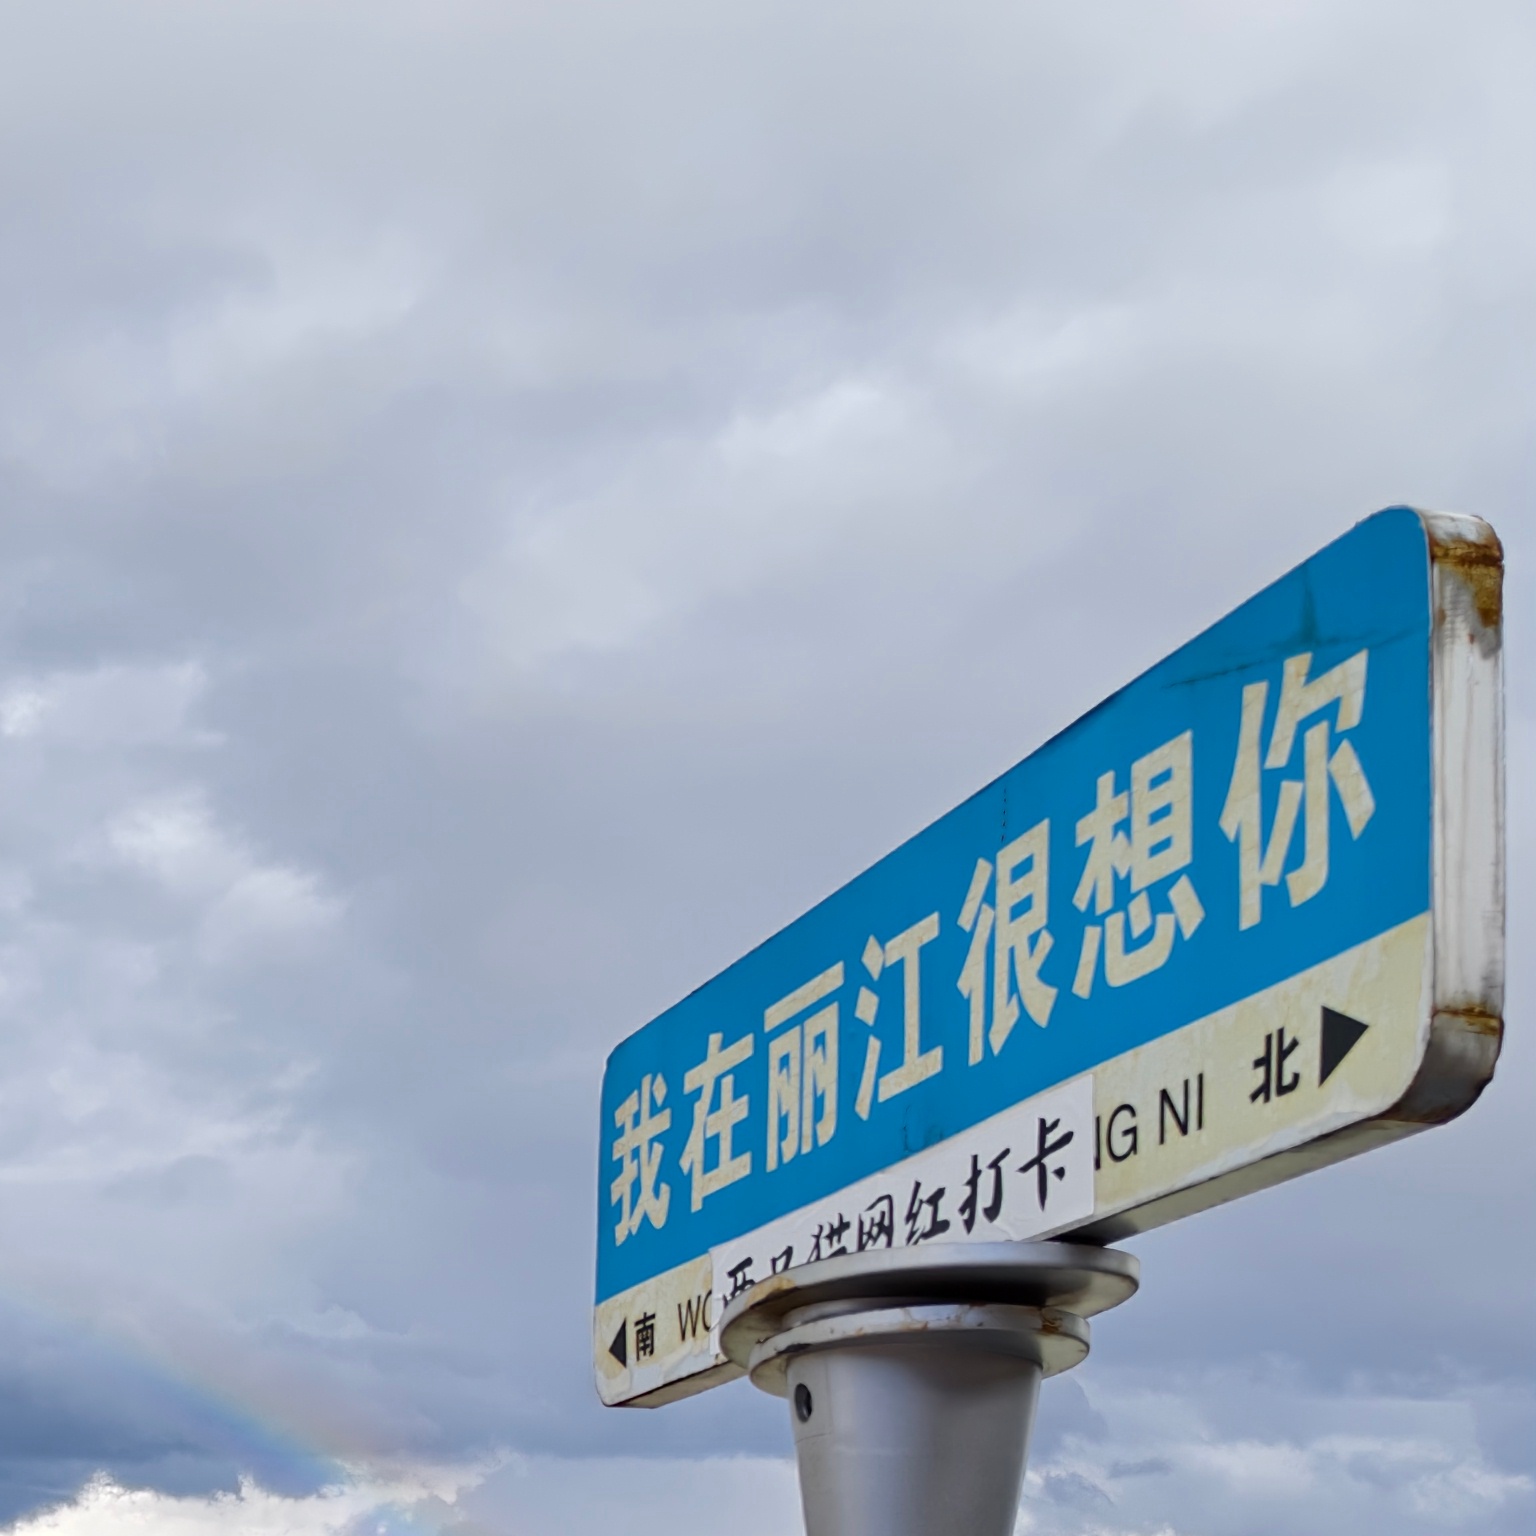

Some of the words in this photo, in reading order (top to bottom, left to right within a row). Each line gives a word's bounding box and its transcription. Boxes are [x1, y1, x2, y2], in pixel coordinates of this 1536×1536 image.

[610, 648, 1376, 1246] 我在丽江很想你
[1249, 1025, 1300, 1104] 北
[1159, 1072, 1204, 1145] NI
[634, 1312, 656, 1362] 南
